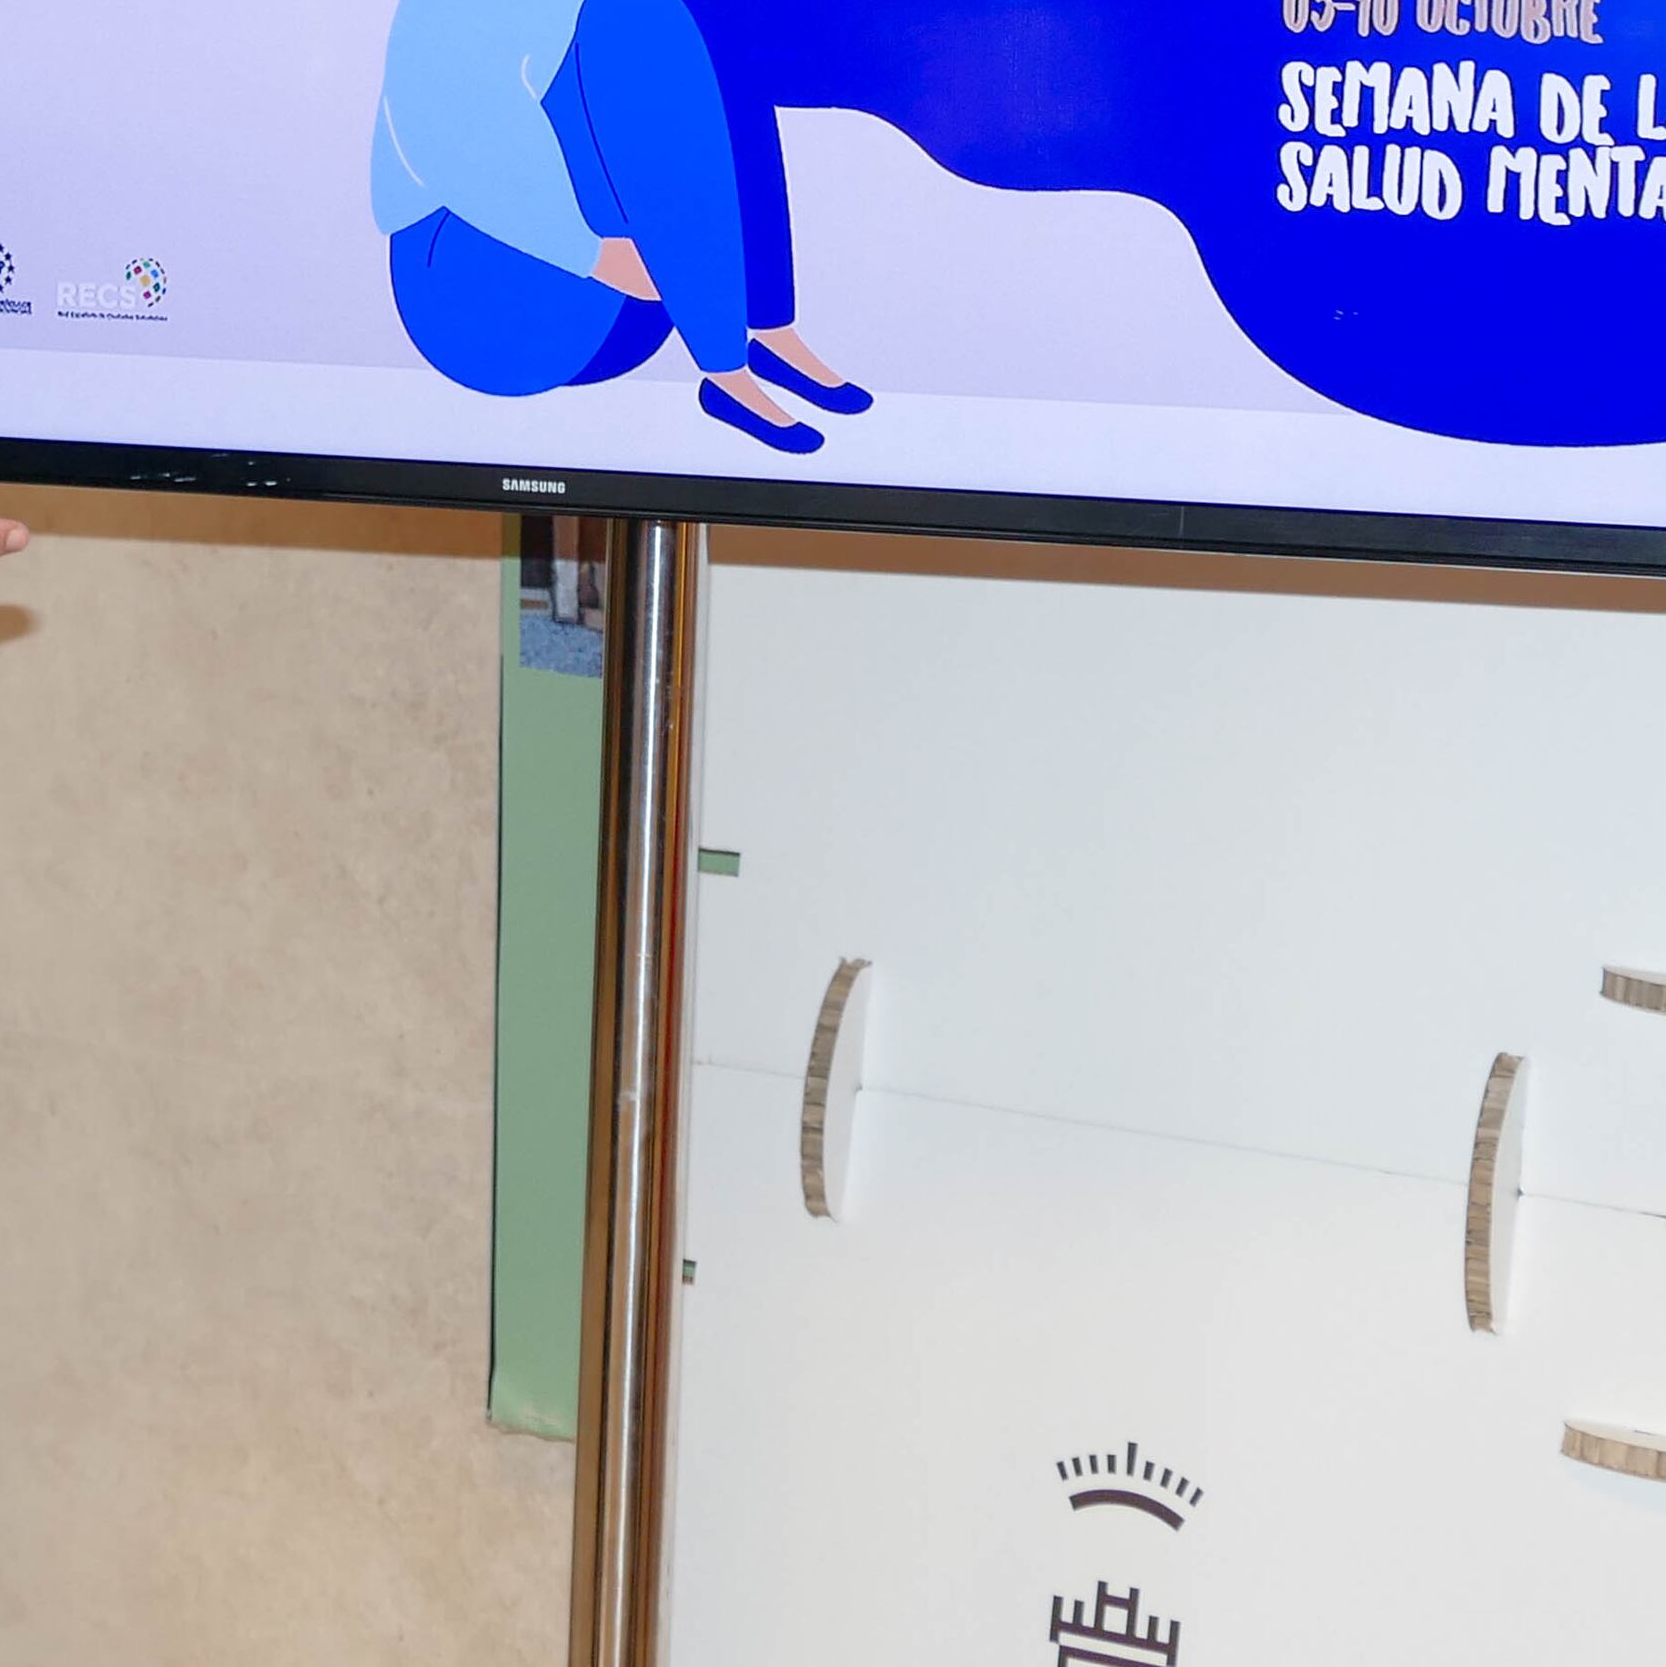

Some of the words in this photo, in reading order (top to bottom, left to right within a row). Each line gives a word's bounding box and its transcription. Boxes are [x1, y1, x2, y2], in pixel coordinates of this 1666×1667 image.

[1278, 60, 1515, 139] SEMANA
[1539, 73, 1614, 146] DE
[1276, 141, 1463, 220] SALUD
[56, 281, 136, 308] RECS
[502, 477, 566, 494] SAMSUNG
